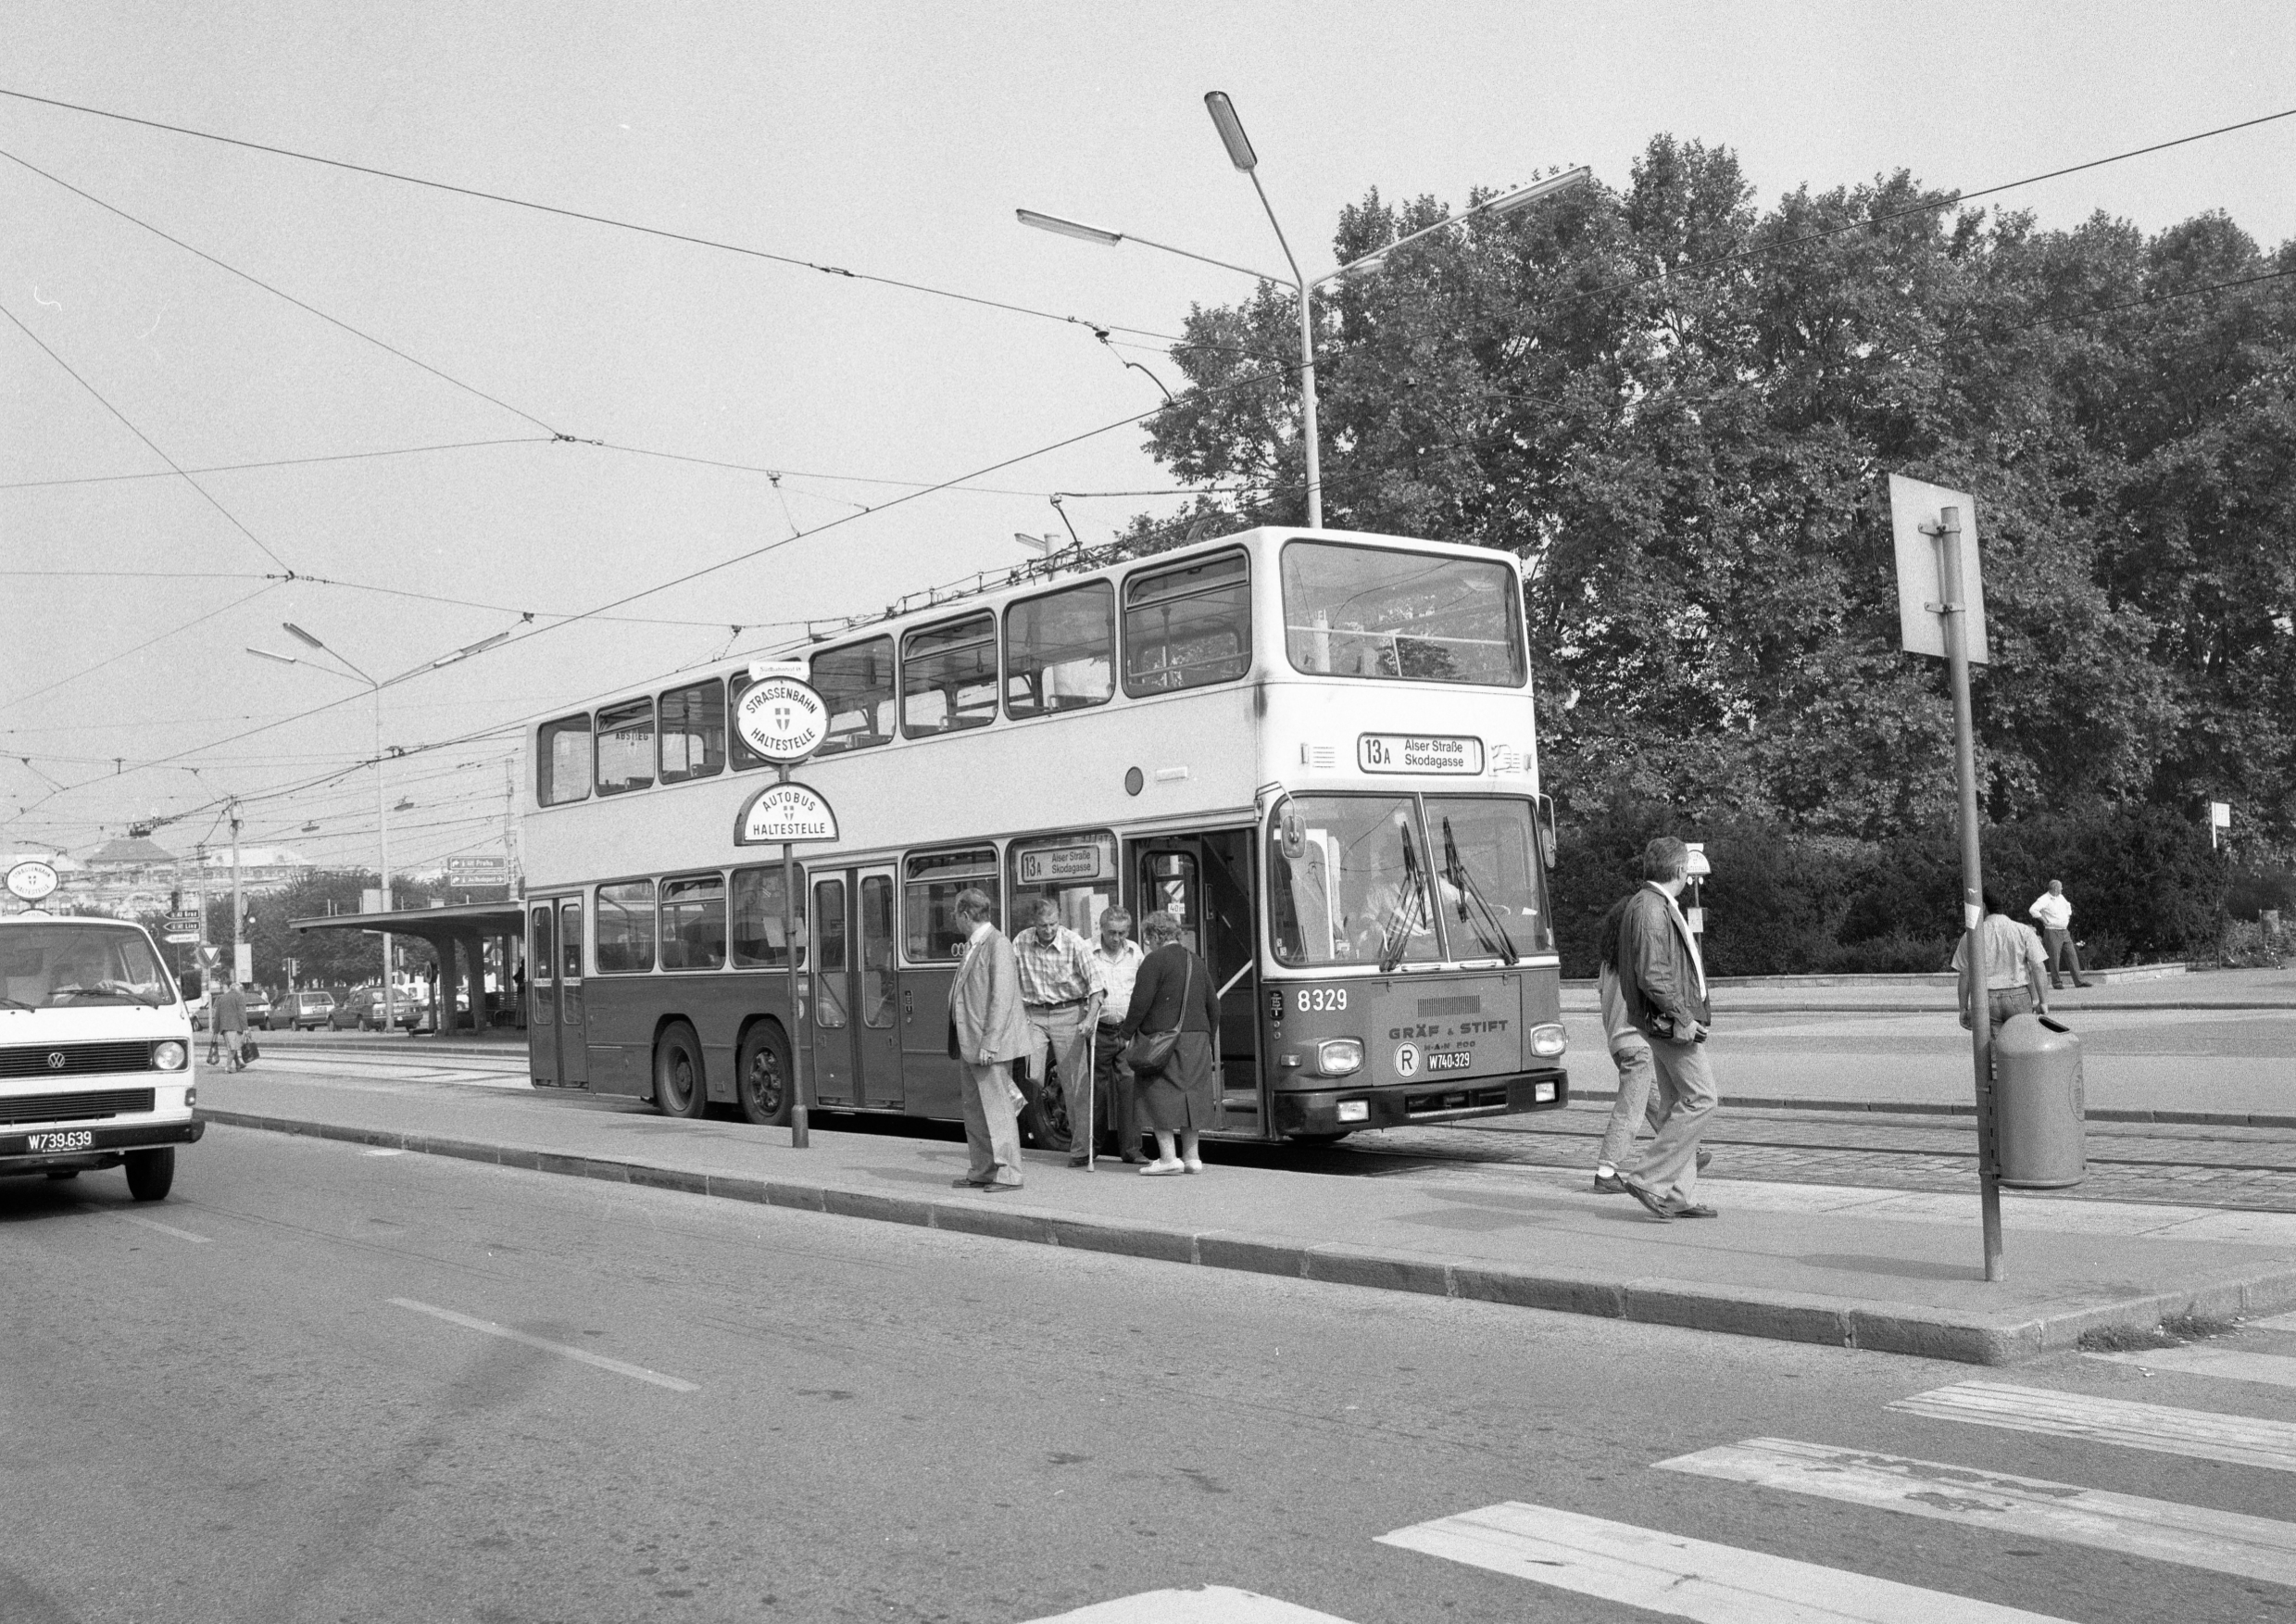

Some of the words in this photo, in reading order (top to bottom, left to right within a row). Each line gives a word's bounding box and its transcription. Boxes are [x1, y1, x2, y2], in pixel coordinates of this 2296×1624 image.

[746, 687, 818, 714] STRASSENBAHN
[750, 727, 816, 751] HALTESTELLE
[1404, 739, 1430, 751] Alser
[1432, 740, 1463, 752] Straße
[1404, 753, 1464, 769] Skodagasse
[762, 791, 816, 812] AUTOBUS
[753, 823, 826, 836] HALTESTELLE
[1051, 852, 1068, 862] Alser
[1069, 850, 1091, 862] Straße
[1051, 863, 1091, 875] Skodagasse
[1298, 988, 1348, 1012] 8329
[1389, 1024, 1439, 1039] GRÄF
[1460, 1020, 1509, 1035] STIFT
[1401, 1050, 1413, 1071] R
